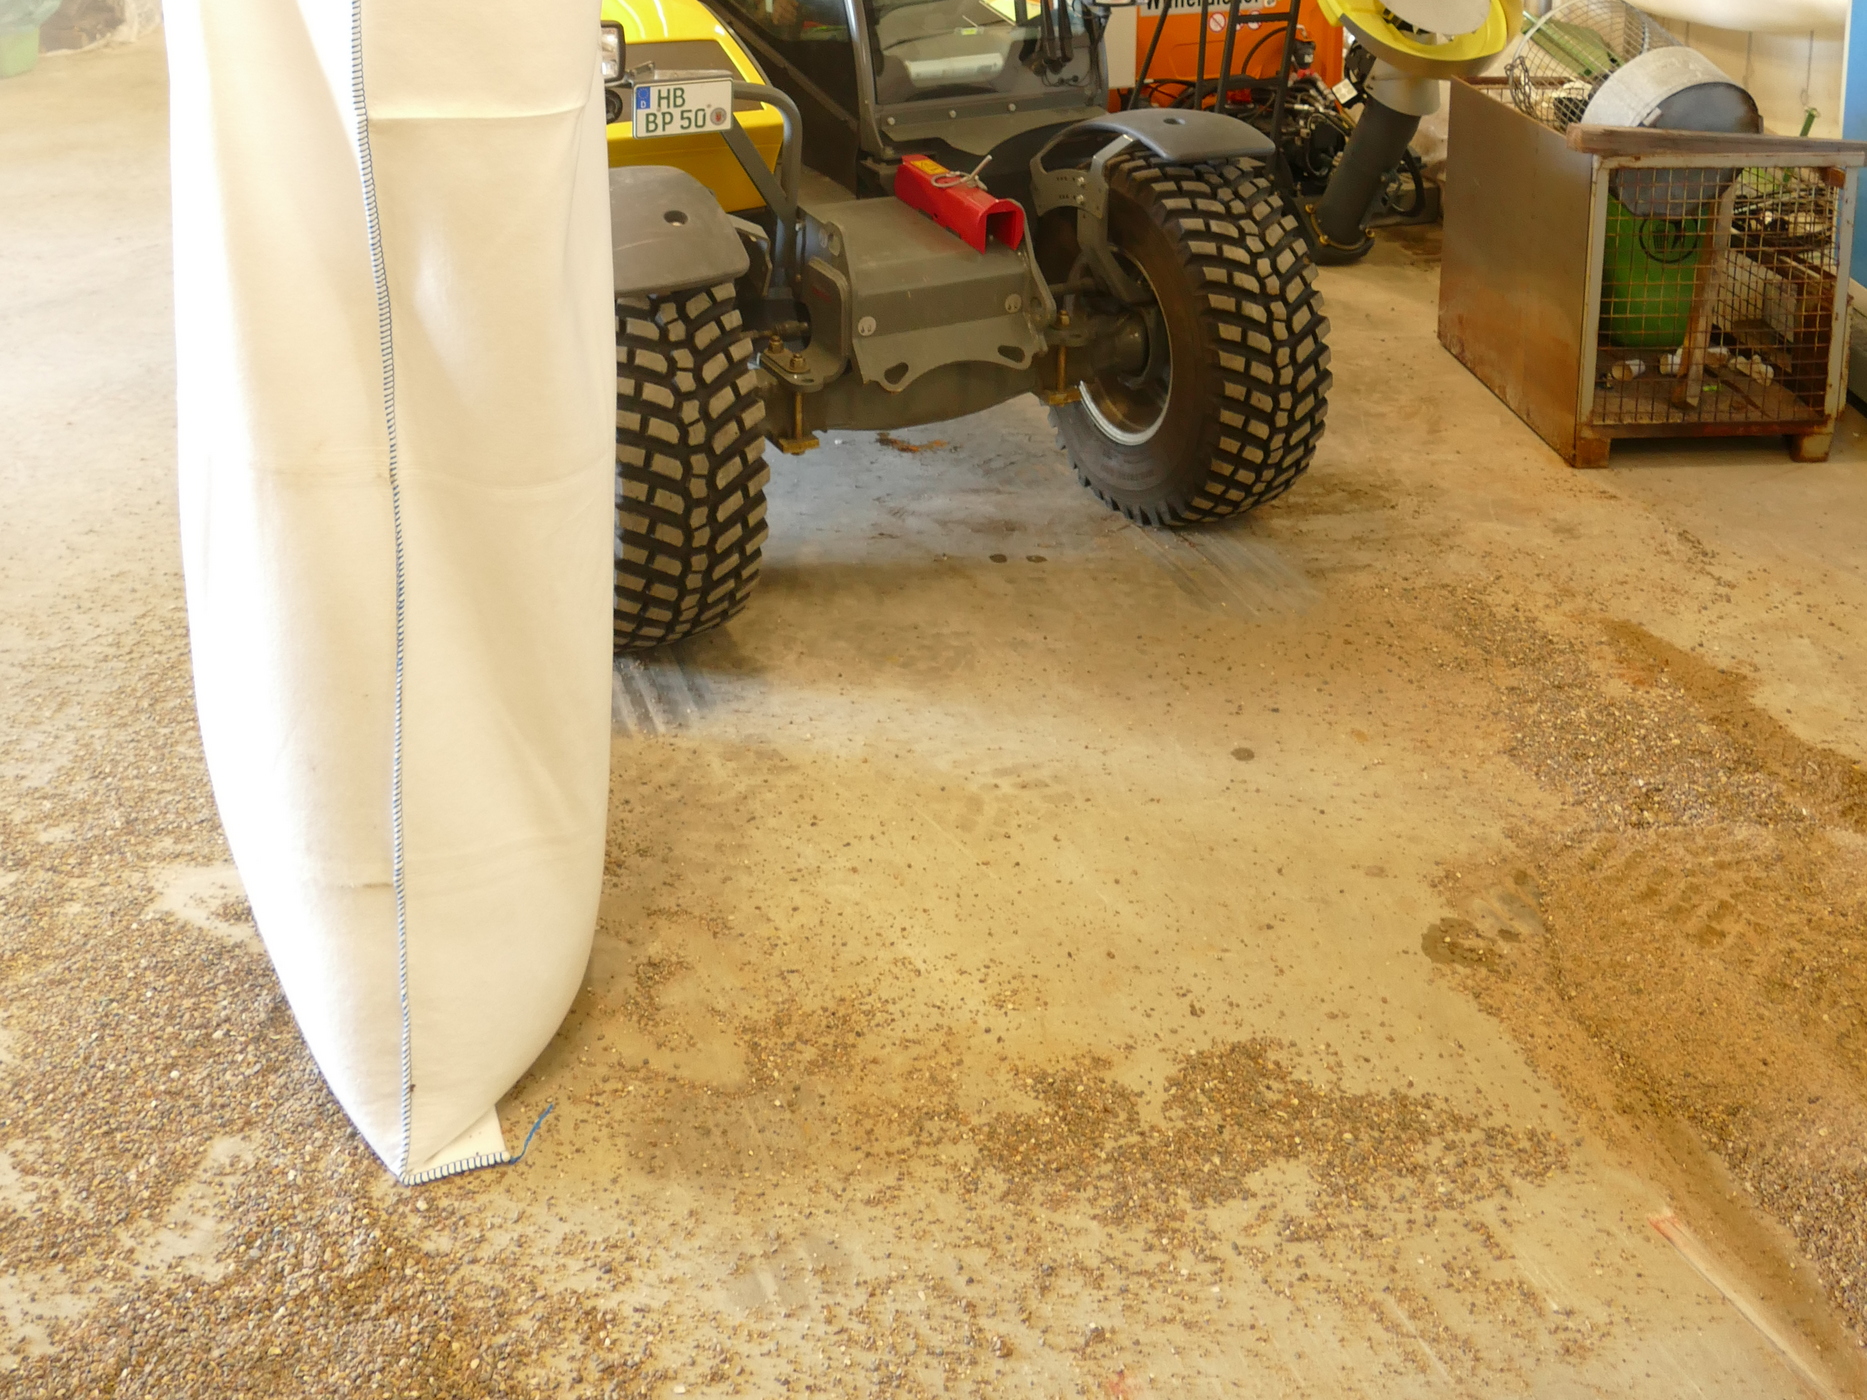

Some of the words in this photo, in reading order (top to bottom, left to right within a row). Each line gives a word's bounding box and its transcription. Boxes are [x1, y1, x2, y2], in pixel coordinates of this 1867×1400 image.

[658, 87, 686, 108] HB
[646, 112, 674, 133] BP
[681, 108, 706, 130] 50
